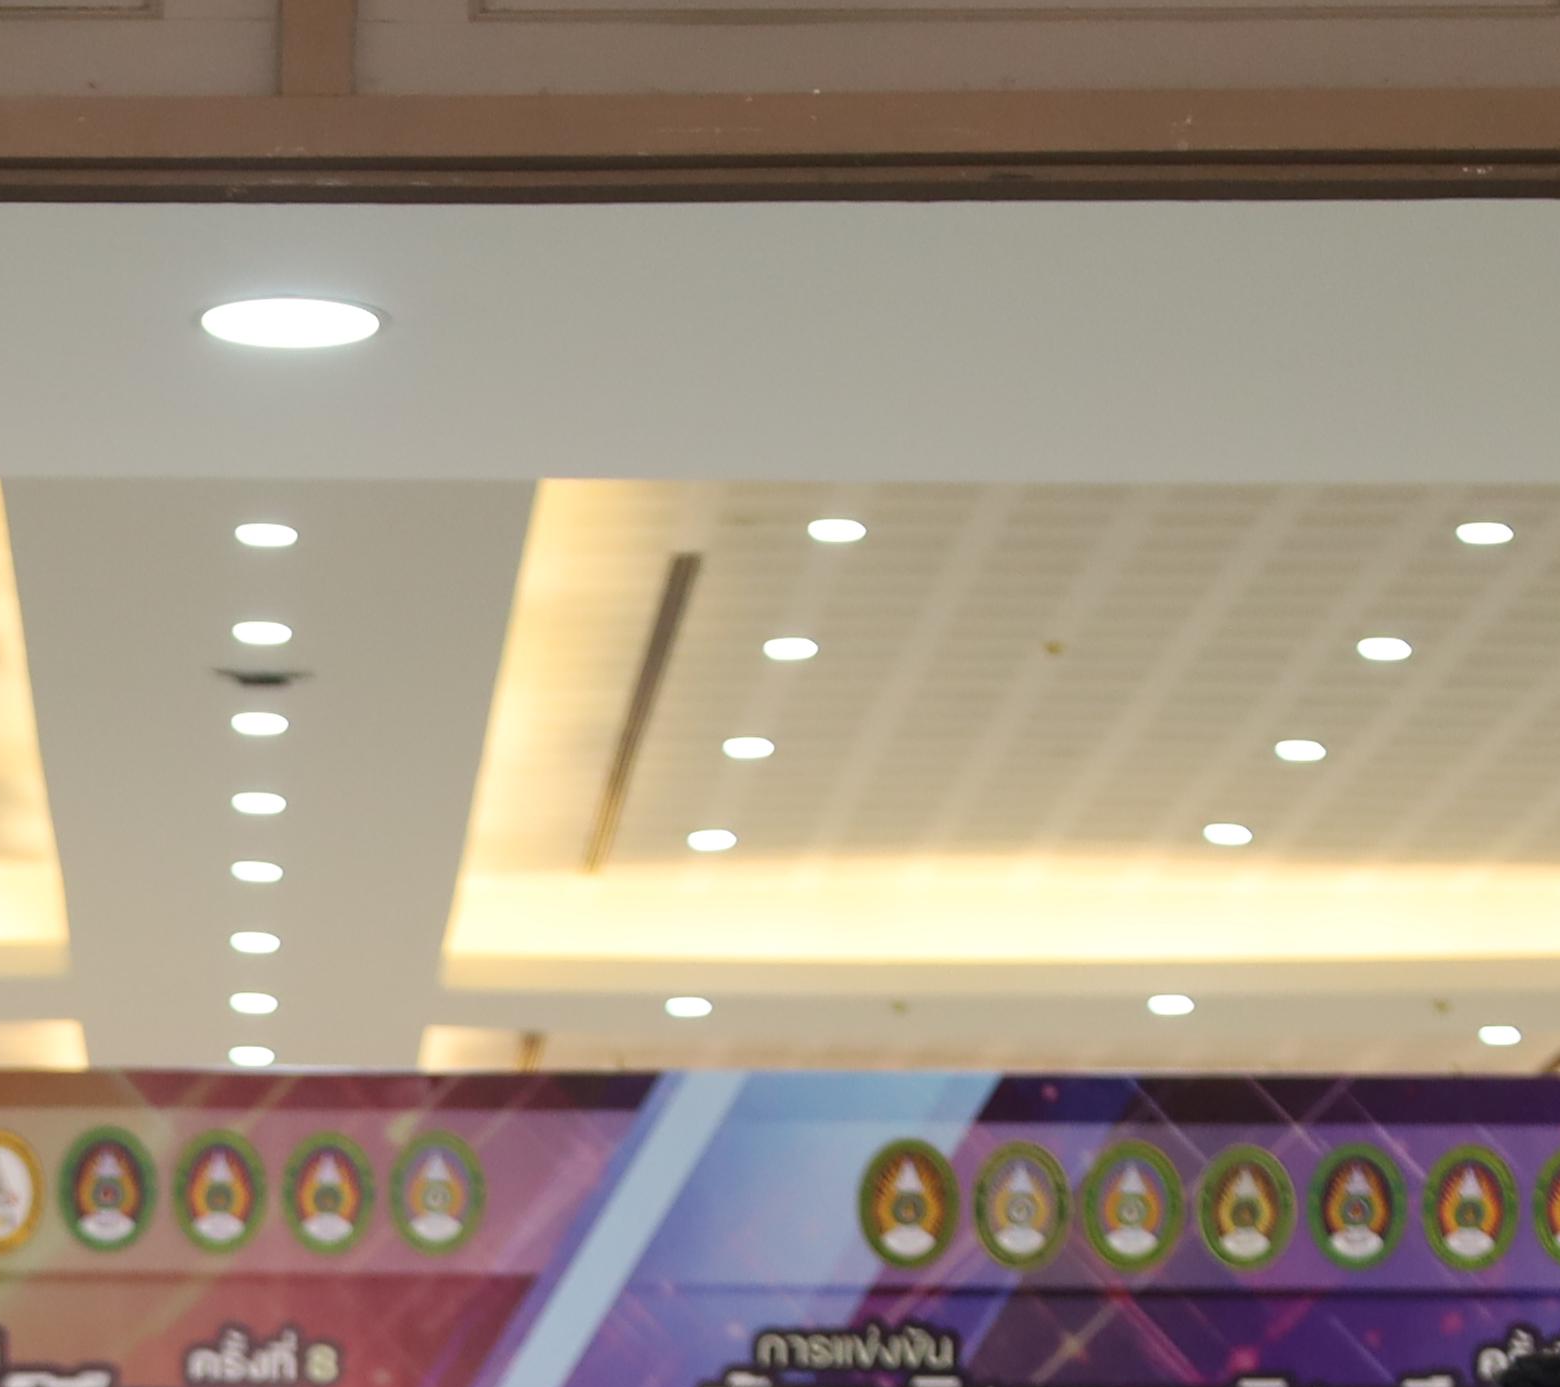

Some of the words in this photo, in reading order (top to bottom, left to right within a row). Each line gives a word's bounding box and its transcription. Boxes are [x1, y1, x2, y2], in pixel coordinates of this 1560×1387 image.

[187, 1328, 298, 1382] ครั้งที่
[305, 1343, 339, 1383] 8
[756, 1326, 955, 1368] การแข่งขัน
